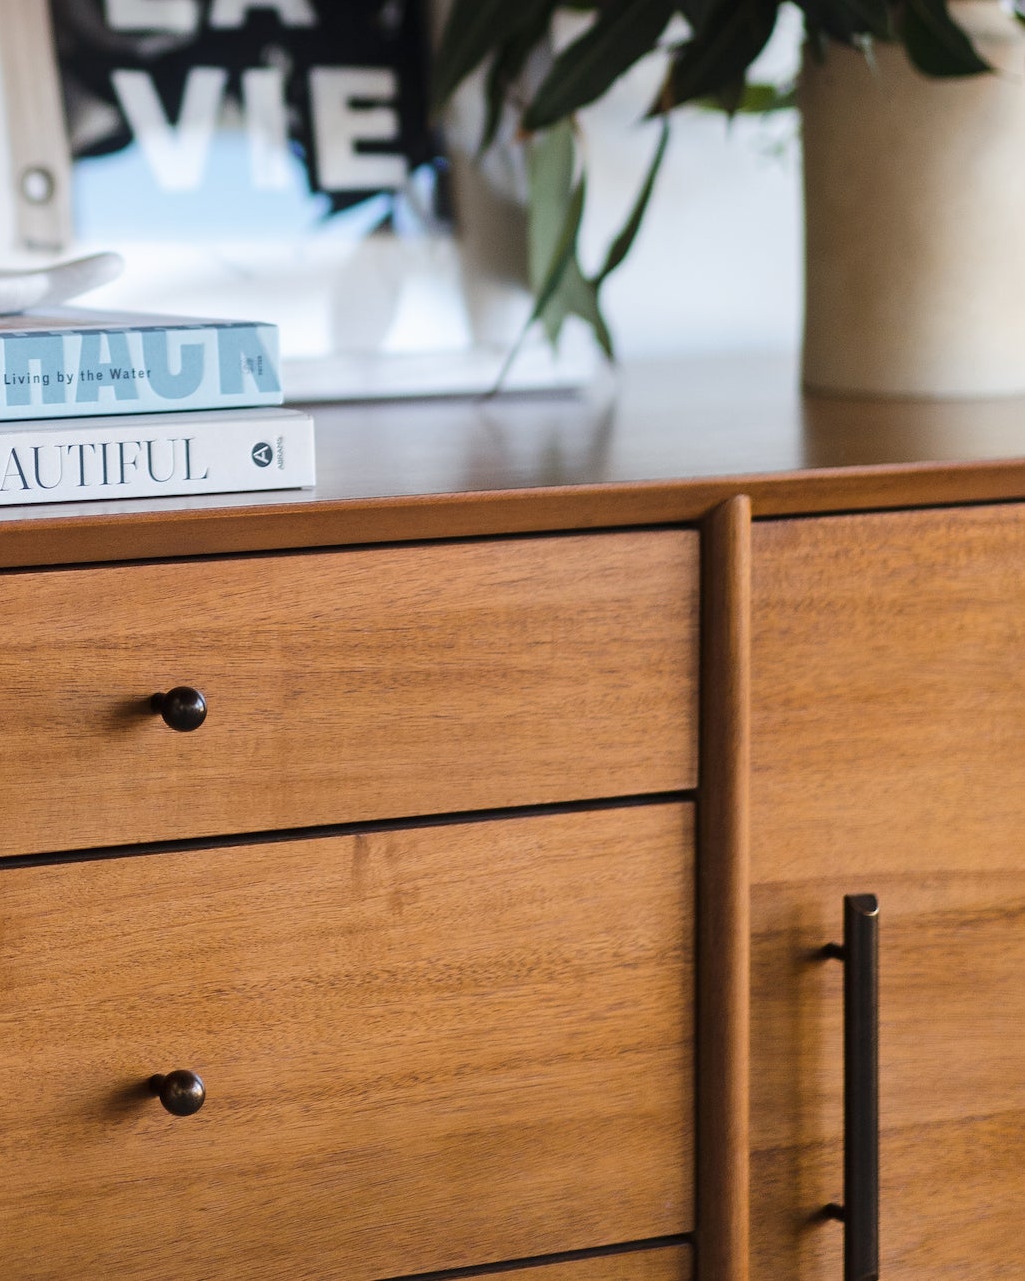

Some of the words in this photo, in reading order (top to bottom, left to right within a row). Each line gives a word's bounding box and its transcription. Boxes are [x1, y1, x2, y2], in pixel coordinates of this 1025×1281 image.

[110, 65, 408, 191] VIE
[3, 372, 50, 388] Living
[56, 370, 74, 386] by
[80, 369, 103, 382] the
[109, 367, 152, 381] Water
